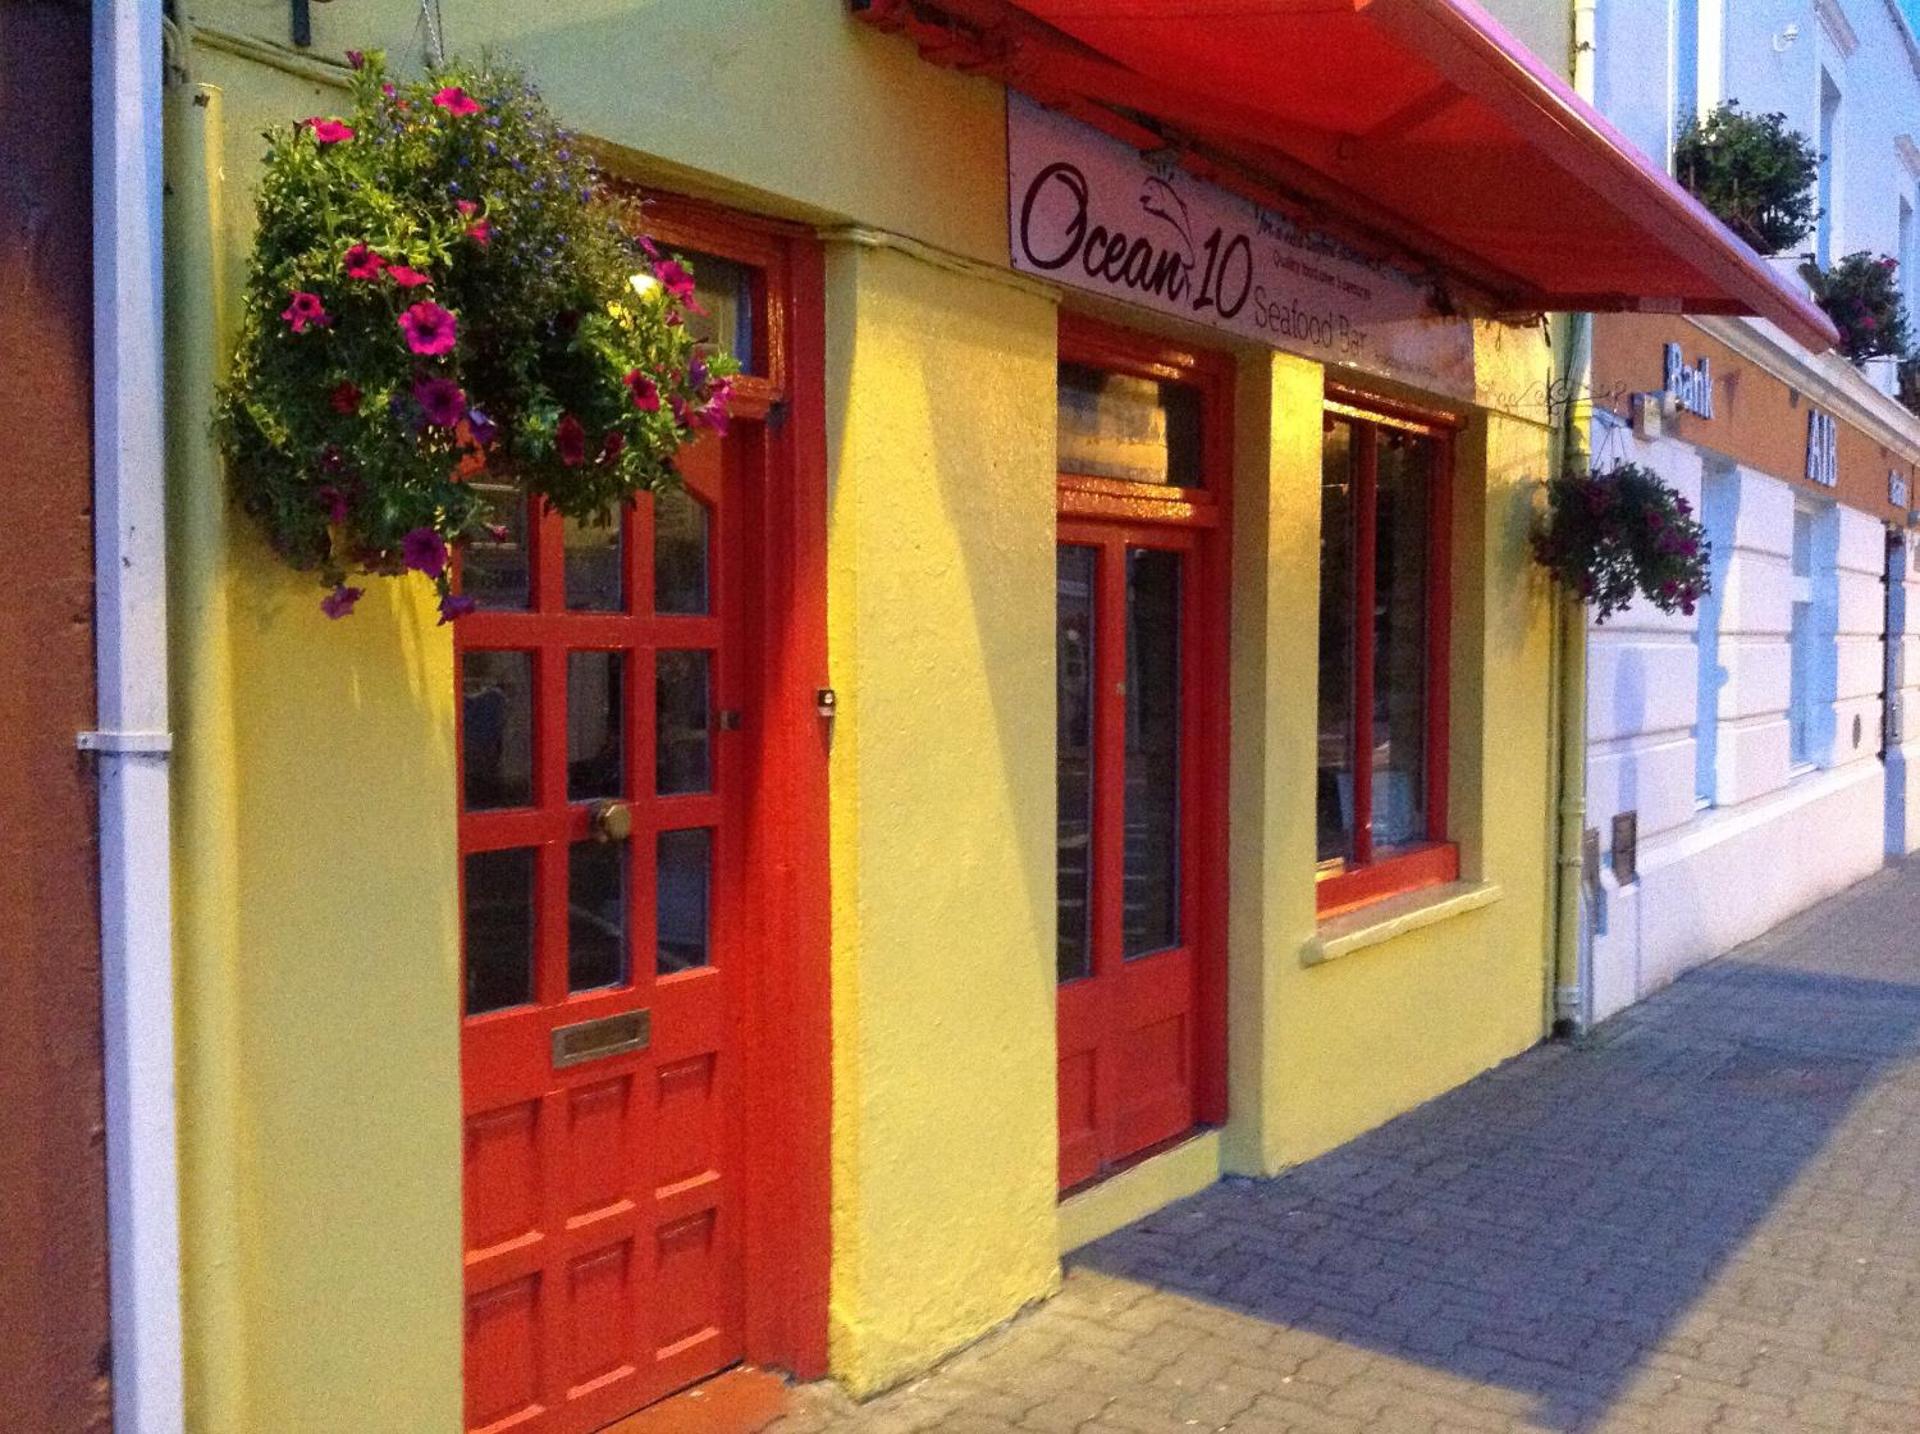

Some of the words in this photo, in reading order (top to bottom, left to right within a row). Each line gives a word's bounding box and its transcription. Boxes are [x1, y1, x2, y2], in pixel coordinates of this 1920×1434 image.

[1021, 161, 1187, 302] Ocean
[1192, 227, 1253, 318] 10
[1253, 285, 1333, 349] Seafood
[1339, 314, 1367, 357] Bar
[1664, 341, 1714, 419] Bank
[1806, 408, 1839, 488] AIB
